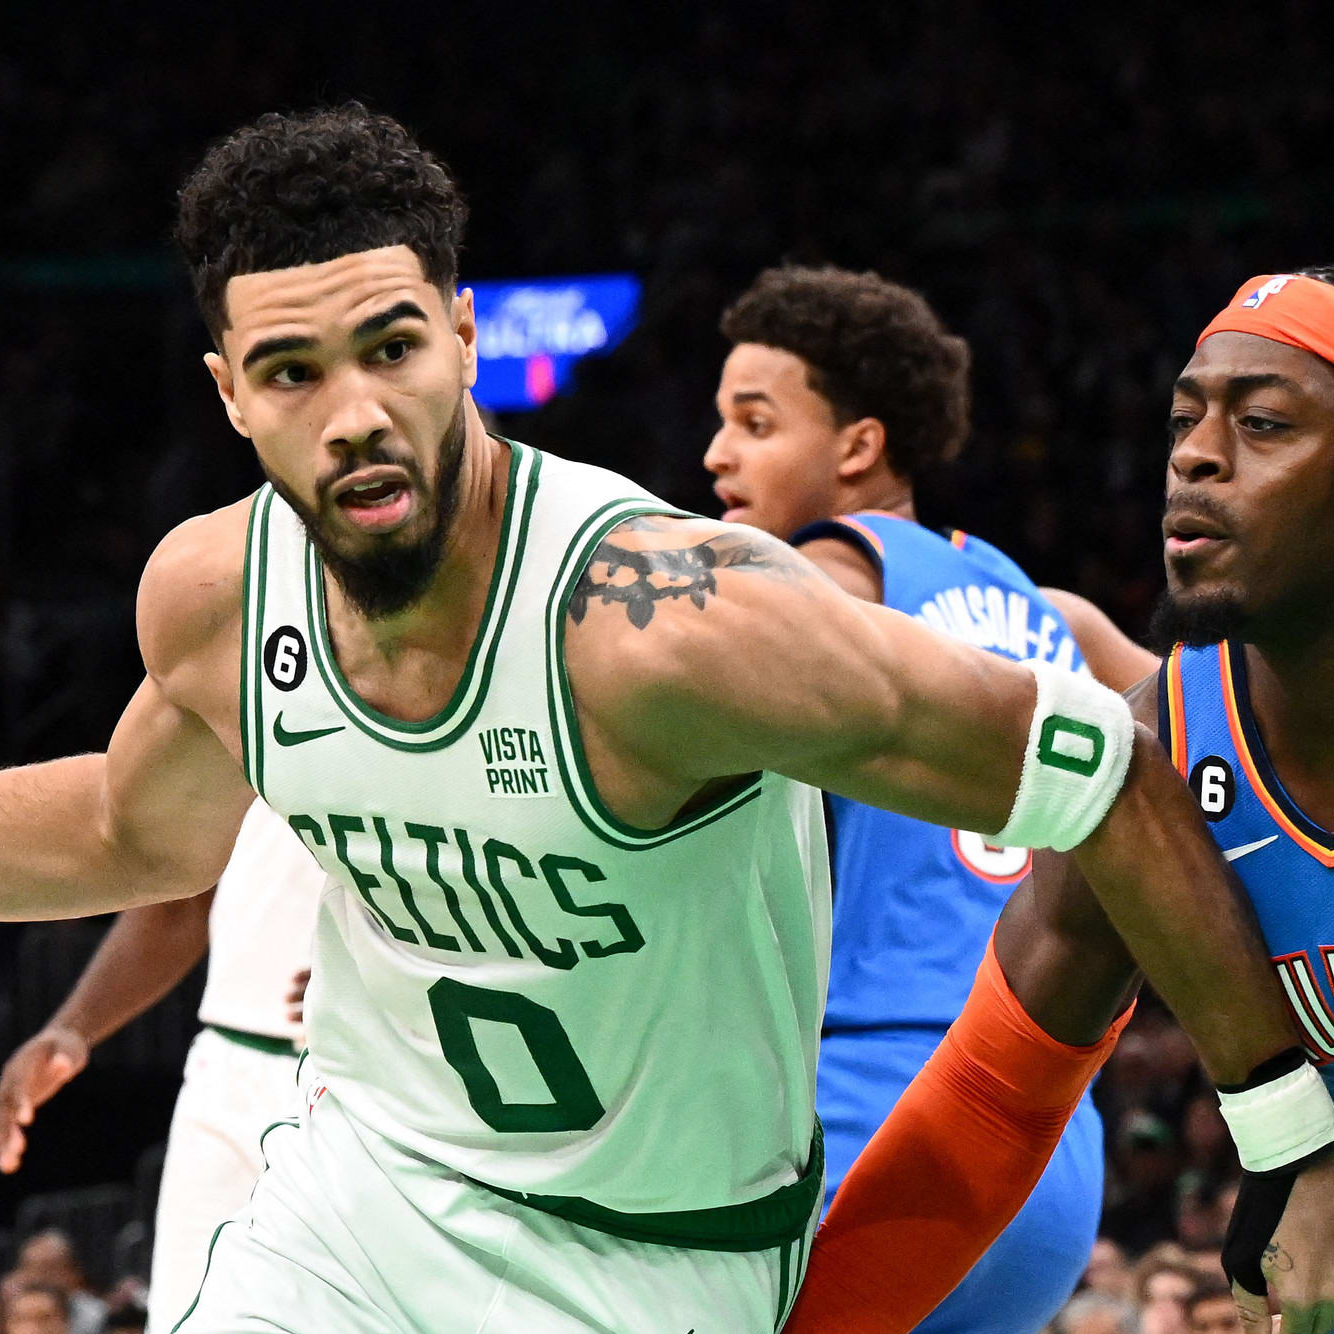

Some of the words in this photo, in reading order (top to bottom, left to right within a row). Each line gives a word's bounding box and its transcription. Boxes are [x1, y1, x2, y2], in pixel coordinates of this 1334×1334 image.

[273, 634, 300, 684] 6
[478, 727, 546, 765] VISTA
[486, 767, 549, 794] PRINT
[1200, 765, 1226, 814] 6
[427, 976, 607, 1133] 0
